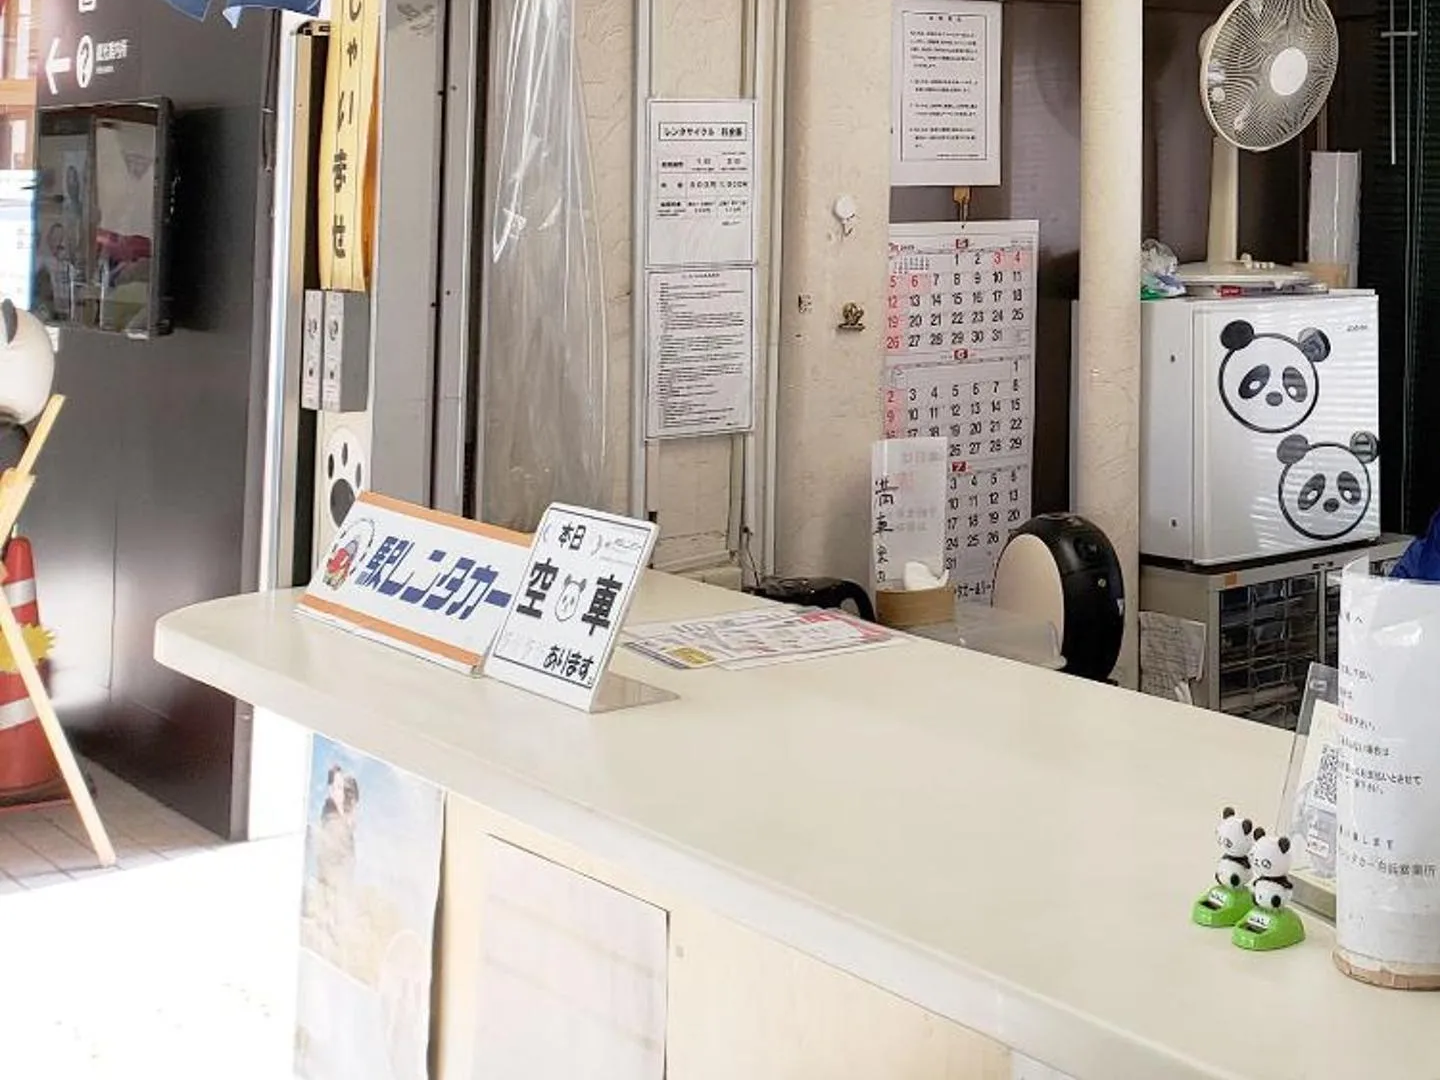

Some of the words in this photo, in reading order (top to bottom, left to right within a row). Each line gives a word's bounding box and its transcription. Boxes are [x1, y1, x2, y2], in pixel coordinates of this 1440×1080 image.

[955, 254, 960, 266] 1
[975, 253, 981, 265] 2
[994, 251, 1001, 264] 3
[1014, 250, 1021, 262] 4
[889, 275, 897, 288] 5
[912, 274, 918, 287] 6
[933, 274, 939, 286] 7
[954, 273, 960, 286] 8
[993, 271, 1003, 284] 10
[887, 296, 898, 309] 12
[909, 294, 920, 307] 13
[931, 293, 941, 306] 14
[952, 292, 962, 305] 15
[993, 290, 1003, 303] 17
[1012, 289, 1022, 302] 18
[909, 315, 922, 327] 20
[931, 313, 941, 326] 21
[951, 312, 963, 324] 22
[971, 311, 984, 323] 23
[1012, 308, 1024, 321] 25
[887, 336, 899, 349] 26
[908, 335, 920, 348] 27
[930, 333, 943, 345] 28
[951, 332, 964, 344] 29
[971, 330, 984, 343] 30
[992, 329, 1002, 341] 31
[558, 521, 587, 551] 本日
[357, 534, 512, 621] 駅レンタカー
[516, 558, 560, 619] 空
[581, 574, 623, 636] 車
